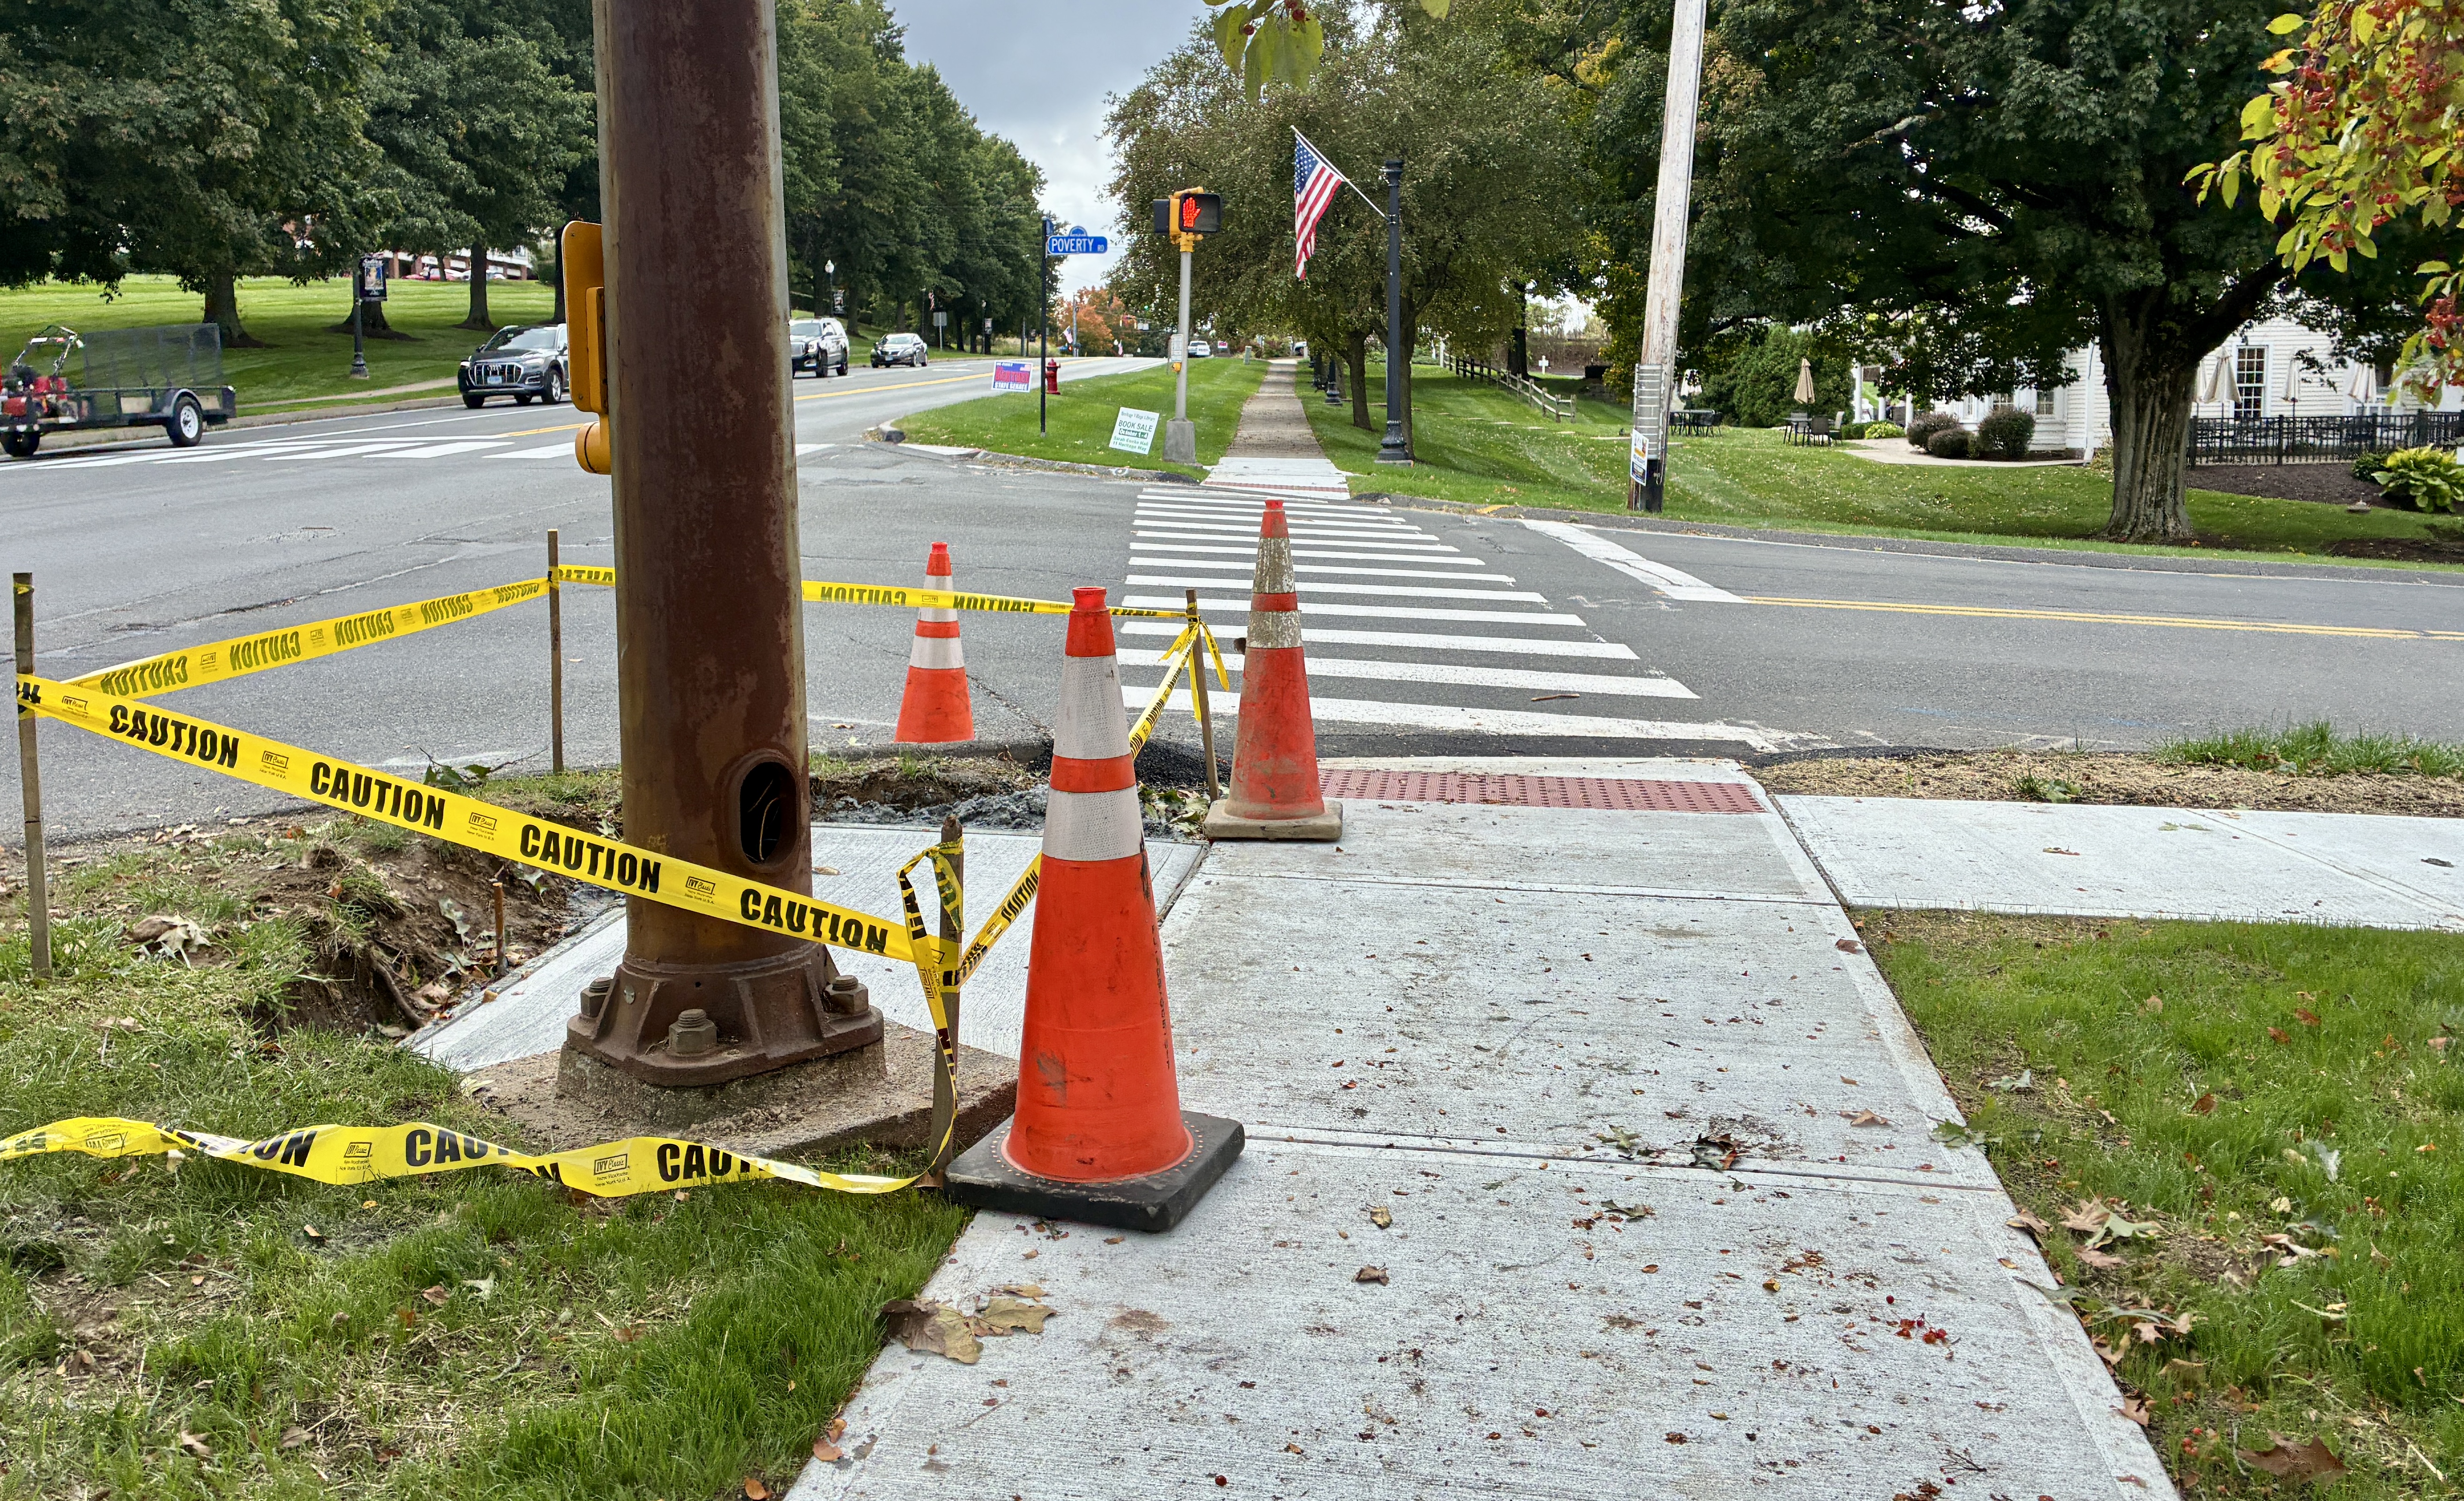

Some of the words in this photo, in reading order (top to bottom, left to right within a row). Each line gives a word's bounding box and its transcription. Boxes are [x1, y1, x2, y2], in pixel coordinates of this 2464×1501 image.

[1051, 238, 1094, 252] POVERTY
[1119, 420, 1136, 428] BOOK
[1136, 423, 1153, 432] SALE
[109, 705, 239, 768] CAUTION
[310, 762, 446, 830] CAUTION
[520, 824, 661, 894] CAUTION
[740, 889, 888, 953] CAUTION
[1001, 869, 1038, 924] CAUTION
[597, 1160, 608, 1172] IVY
